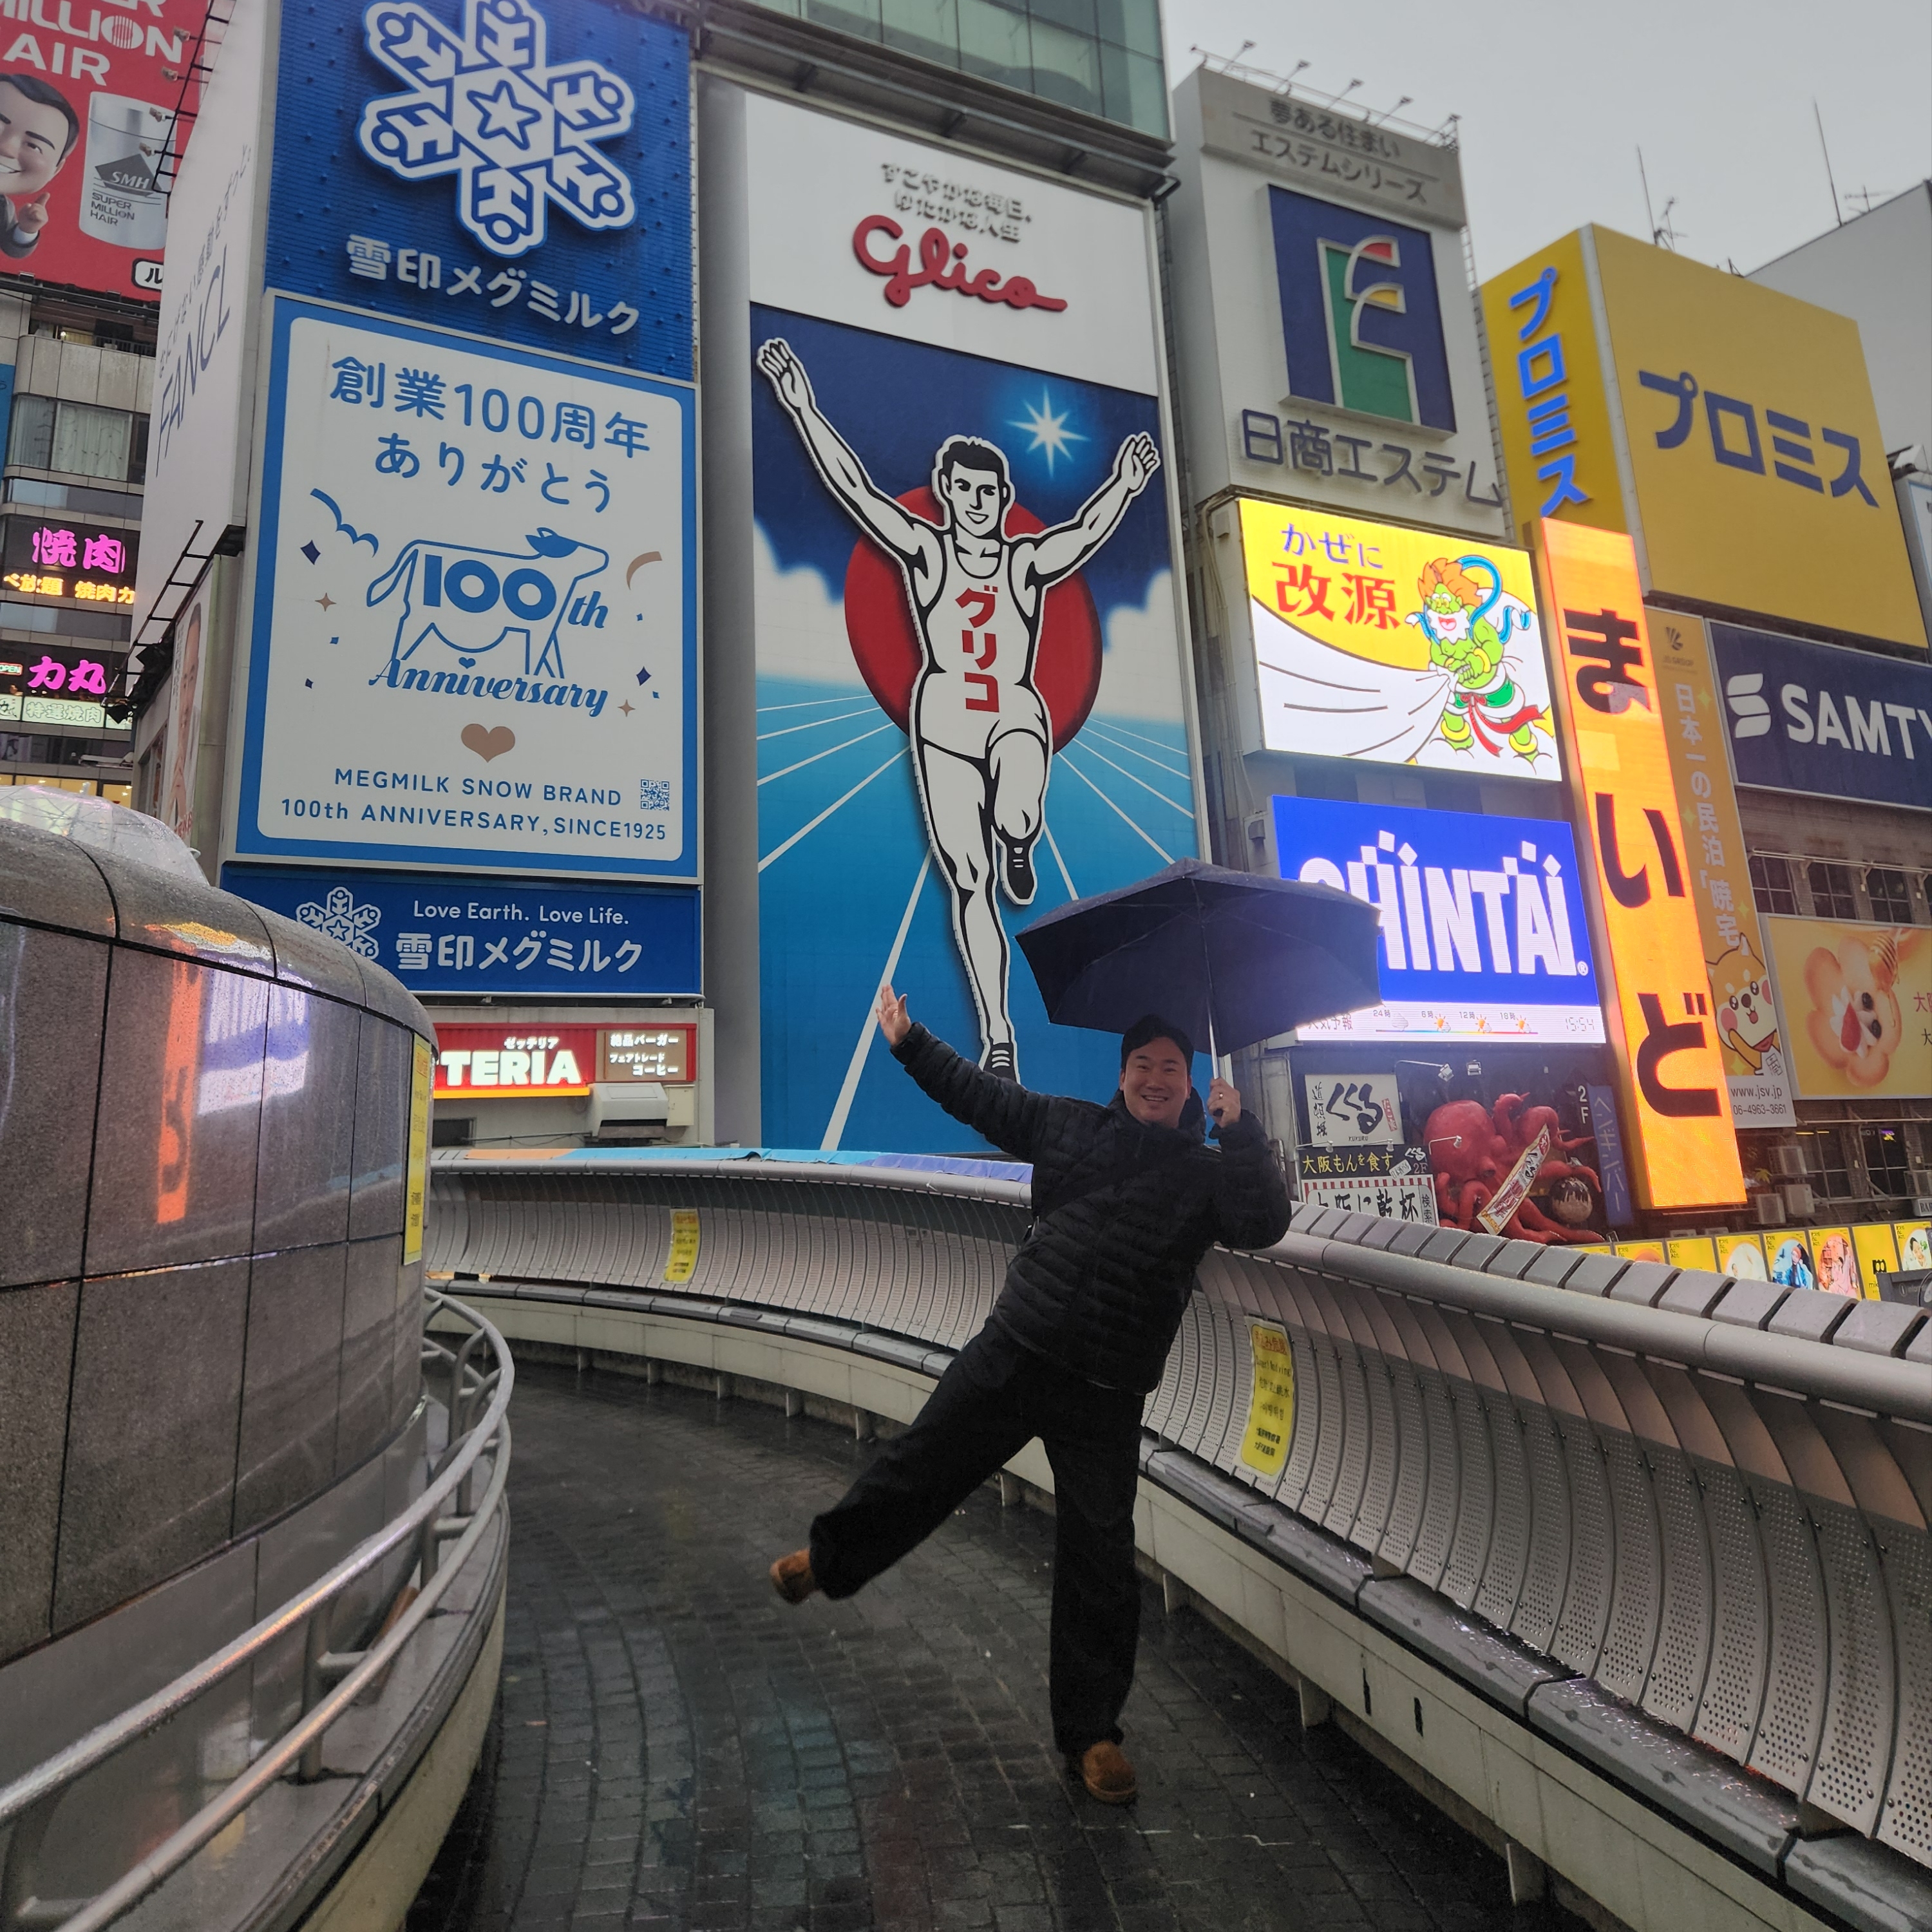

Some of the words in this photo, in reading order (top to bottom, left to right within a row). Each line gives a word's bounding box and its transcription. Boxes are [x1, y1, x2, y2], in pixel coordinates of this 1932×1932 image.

[1269, 97, 1401, 158] 夢ある住まい
[112, 172, 149, 189] SMH
[1251, 131, 1427, 204] エステムシリーズ
[91, 201, 135, 220] MILLION
[91, 210, 118, 226] HAIR
[92, 192, 132, 210] SUPER
[895, 192, 1021, 243] ゆたかな人生
[853, 214, 1068, 312] Glico
[346, 234, 639, 335] 雪印メグミルク
[156, 245, 231, 478] FANCL
[330, 356, 650, 458] 創業100周年
[1509, 266, 1589, 518] プロミス
[1242, 409, 1502, 507] 日商エステム
[1638, 370, 1879, 509] プロミス
[375, 433, 611, 513] ありがとう
[33, 527, 126, 573] 焼肉
[1281, 523, 1383, 569] かぜに
[1272, 562, 1401, 630] 改源
[955, 585, 999, 713] グリコ
[28, 656, 106, 694] 力丸
[368, 659, 608, 717] Anniversary
[27, 702, 102, 724] 特選焼肉
[335, 768, 450, 793] MEGMILK
[462, 779, 533, 799] SNOW
[544, 785, 621, 806] BRAND
[282, 799, 348, 820] 100th
[1564, 609, 1723, 1117] まいど
[414, 900, 460, 919] Love
[468, 903, 528, 921] Earth.
[540, 905, 583, 923] Love
[589, 907, 629, 925] Life.
[1300, 831, 1577, 976] HINTAI
[396, 929, 643, 973] 雪印メグミルク
[504, 1036, 559, 1050] ゼッテリア
[610, 1033, 679, 1047] 絶品バーガー
[1566, 1018, 1595, 1031] 15:54
[437, 1050, 582, 1086] TERIA
[609, 1052, 665, 1063] フェアトレード
[632, 1065, 679, 1076] コーヒー
[1312, 1082, 1327, 1137] 道頓堀
[1326, 1083, 1383, 1134] くくる
[1730, 1085, 1782, 1099] www.jsv.jp
[1733, 1104, 1786, 1115] 06-4963-3661
[1302, 1151, 1393, 1174] 大阪もんを食す
[1405, 1148, 1426, 1161] くくる
[1414, 1162, 1428, 1174] 2F
[1421, 1194, 1433, 1223] 検索
